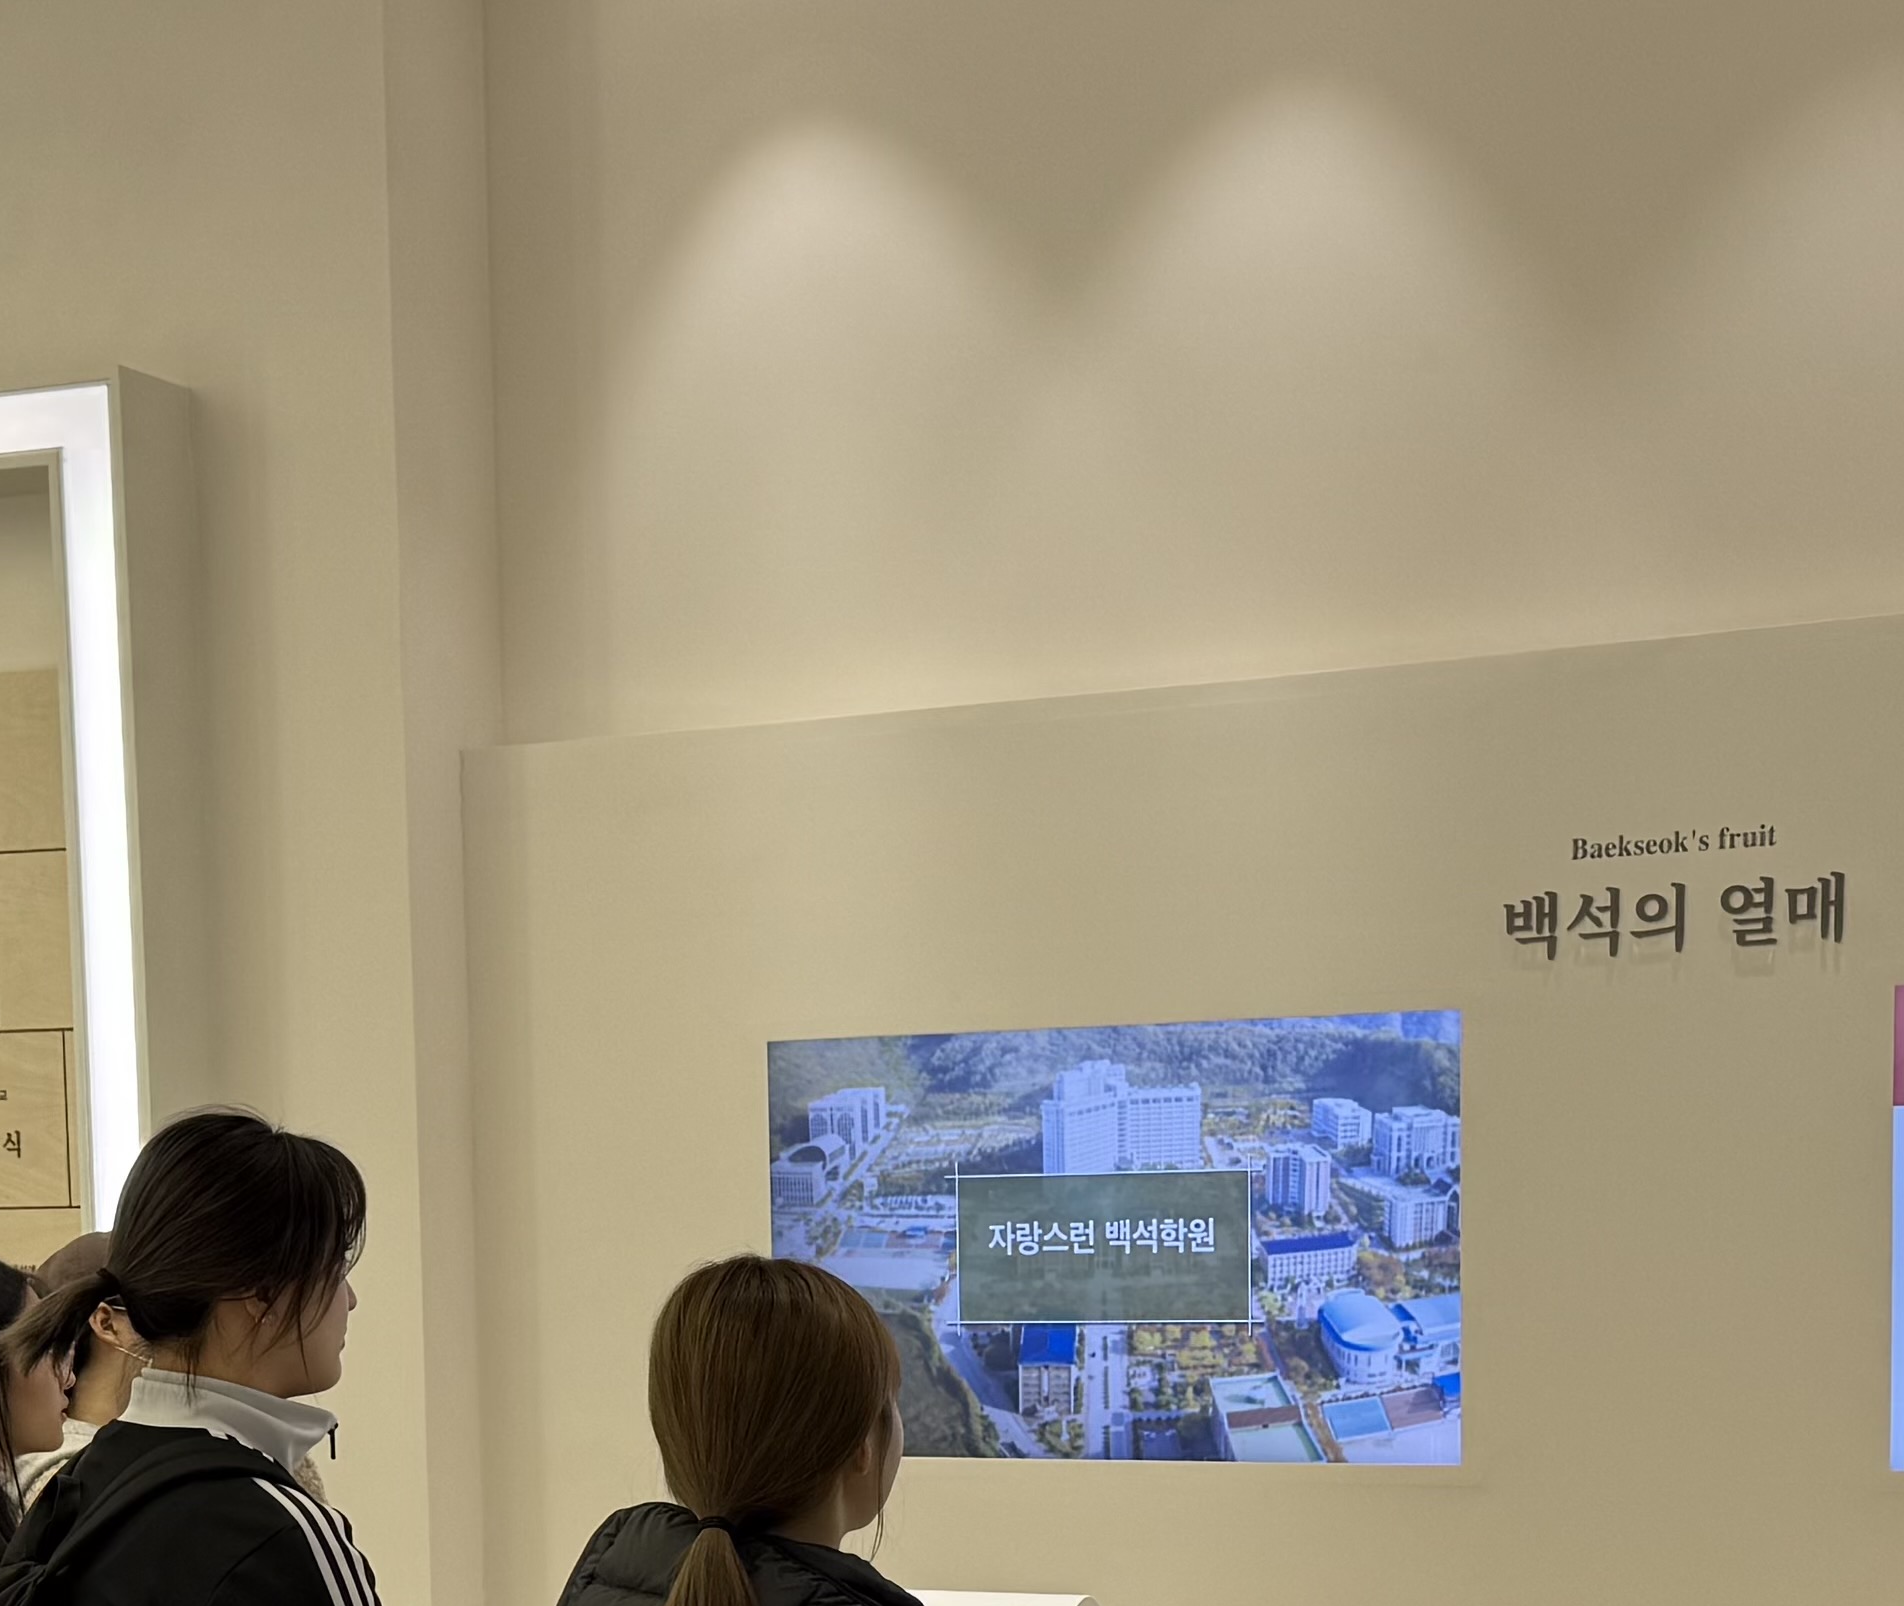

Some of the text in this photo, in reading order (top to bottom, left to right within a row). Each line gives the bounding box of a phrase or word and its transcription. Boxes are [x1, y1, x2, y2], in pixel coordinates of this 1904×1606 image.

[1571, 824, 1778, 860] Baekseok's fruit
[1503, 871, 1846, 961] 백석의 열매
[988, 1217, 1215, 1256] 자랑스런 백석학원
